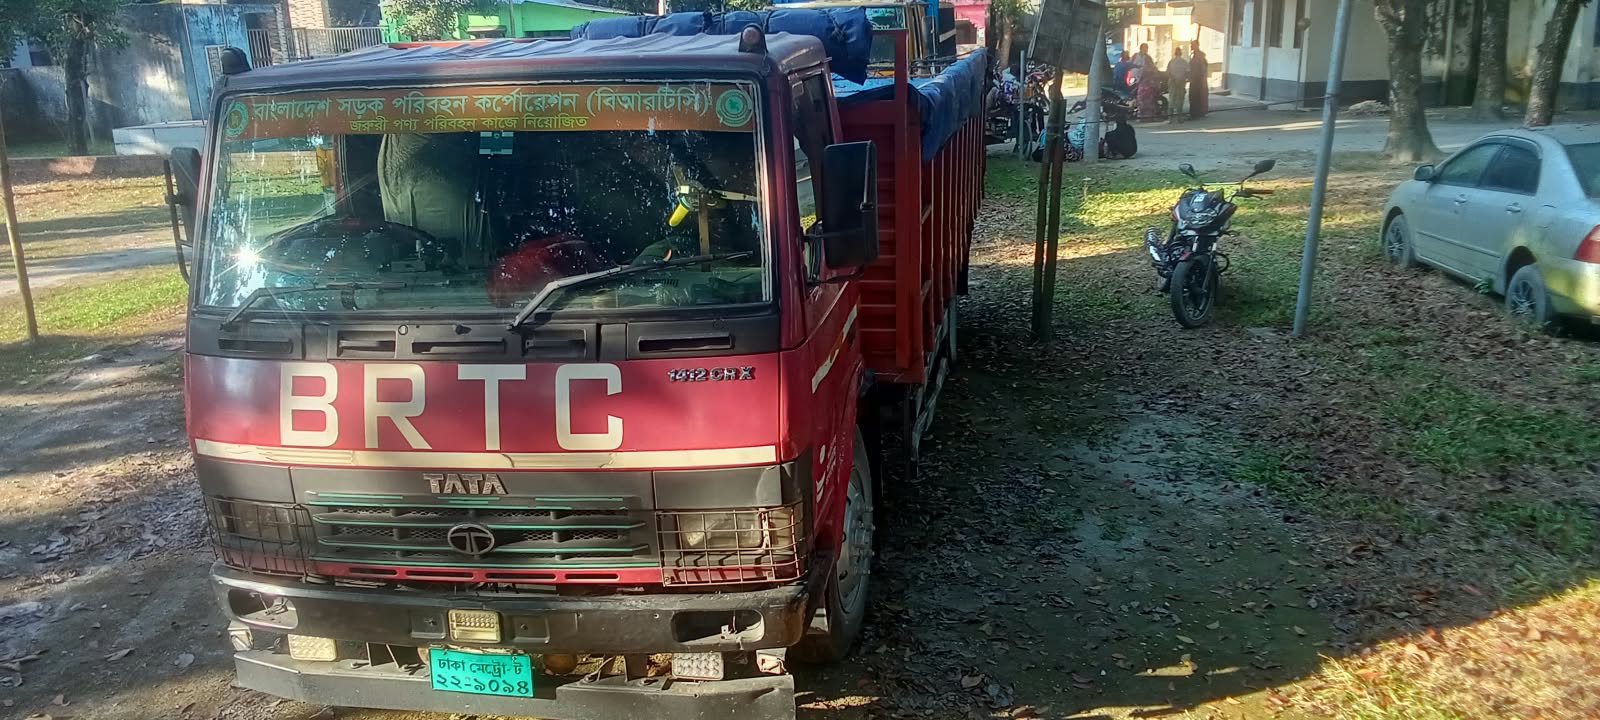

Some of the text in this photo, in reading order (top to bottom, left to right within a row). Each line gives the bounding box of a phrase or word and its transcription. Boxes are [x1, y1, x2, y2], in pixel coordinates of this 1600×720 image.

[252, 97, 332, 120] বাংলাদেশ
[336, 97, 387, 119] সড়ক
[391, 91, 468, 116] পরিবহন
[472, 88, 580, 113] কর্পোরেশন
[586, 83, 709, 117] (বিআরটিসি)
[350, 112, 589, 131] জরুরী পণ্য পরিবহন কাজে নিয়োজিত
[667, 368, 707, 382] 1412
[280, 362, 623, 450] BRTC
[423, 473, 508, 495] TATA
[437, 657, 466, 673] ঢাকা
[436, 674, 530, 695] ২২-৯০৯৪
